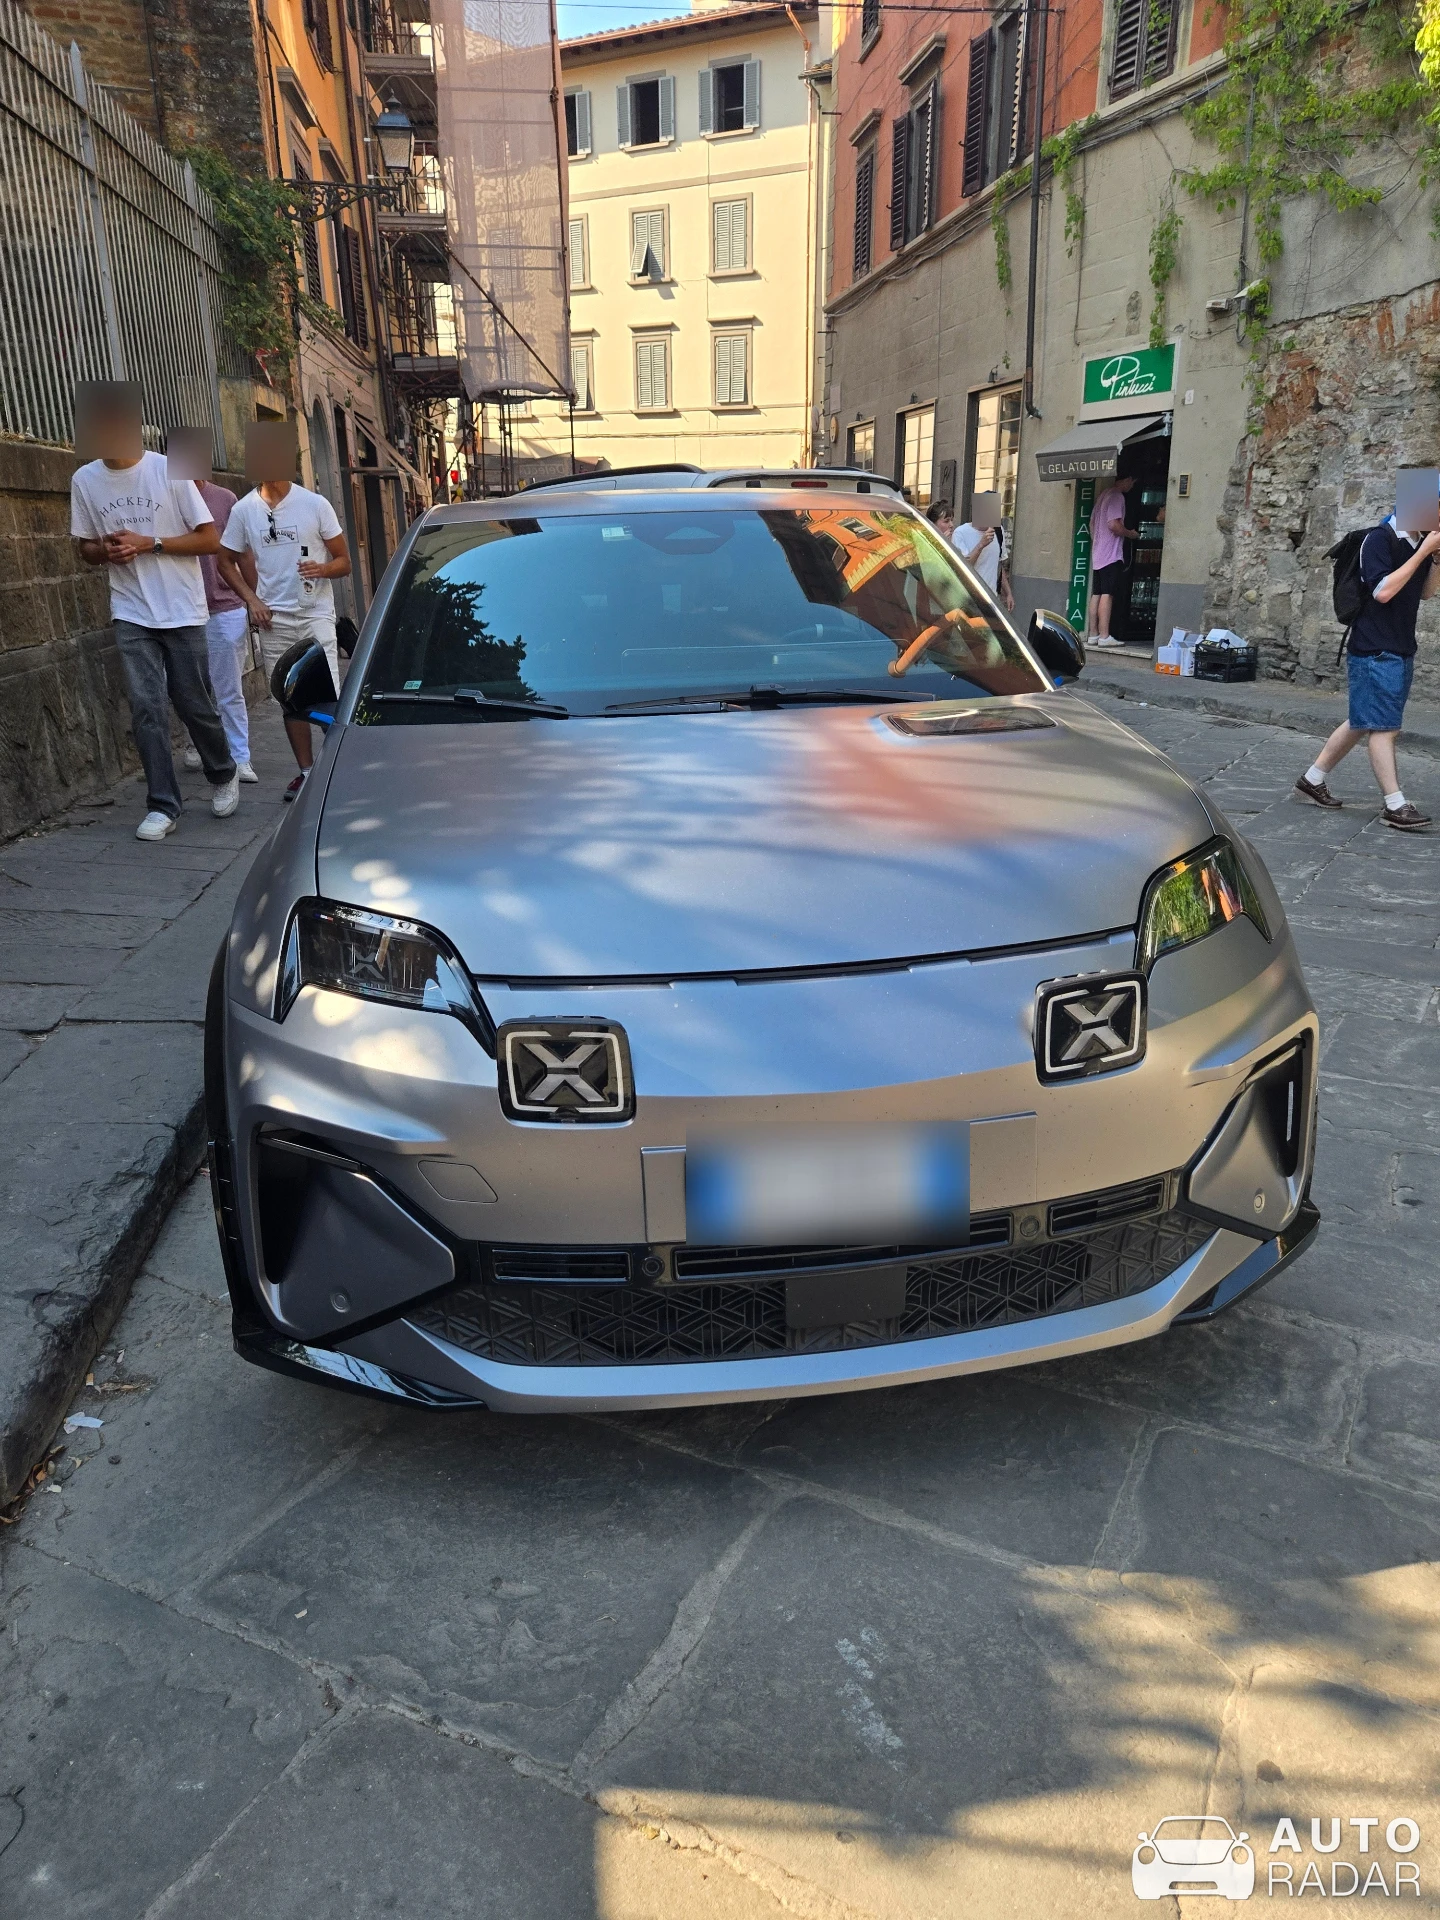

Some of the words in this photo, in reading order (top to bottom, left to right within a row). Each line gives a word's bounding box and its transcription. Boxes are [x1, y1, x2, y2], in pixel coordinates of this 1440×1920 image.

[1101, 356, 1156, 400] Pintucci
[1048, 461, 1087, 474] GELATO
[1089, 460, 1099, 471] DI
[100, 496, 163, 518] HACKETT
[116, 517, 151, 526] LONDON
